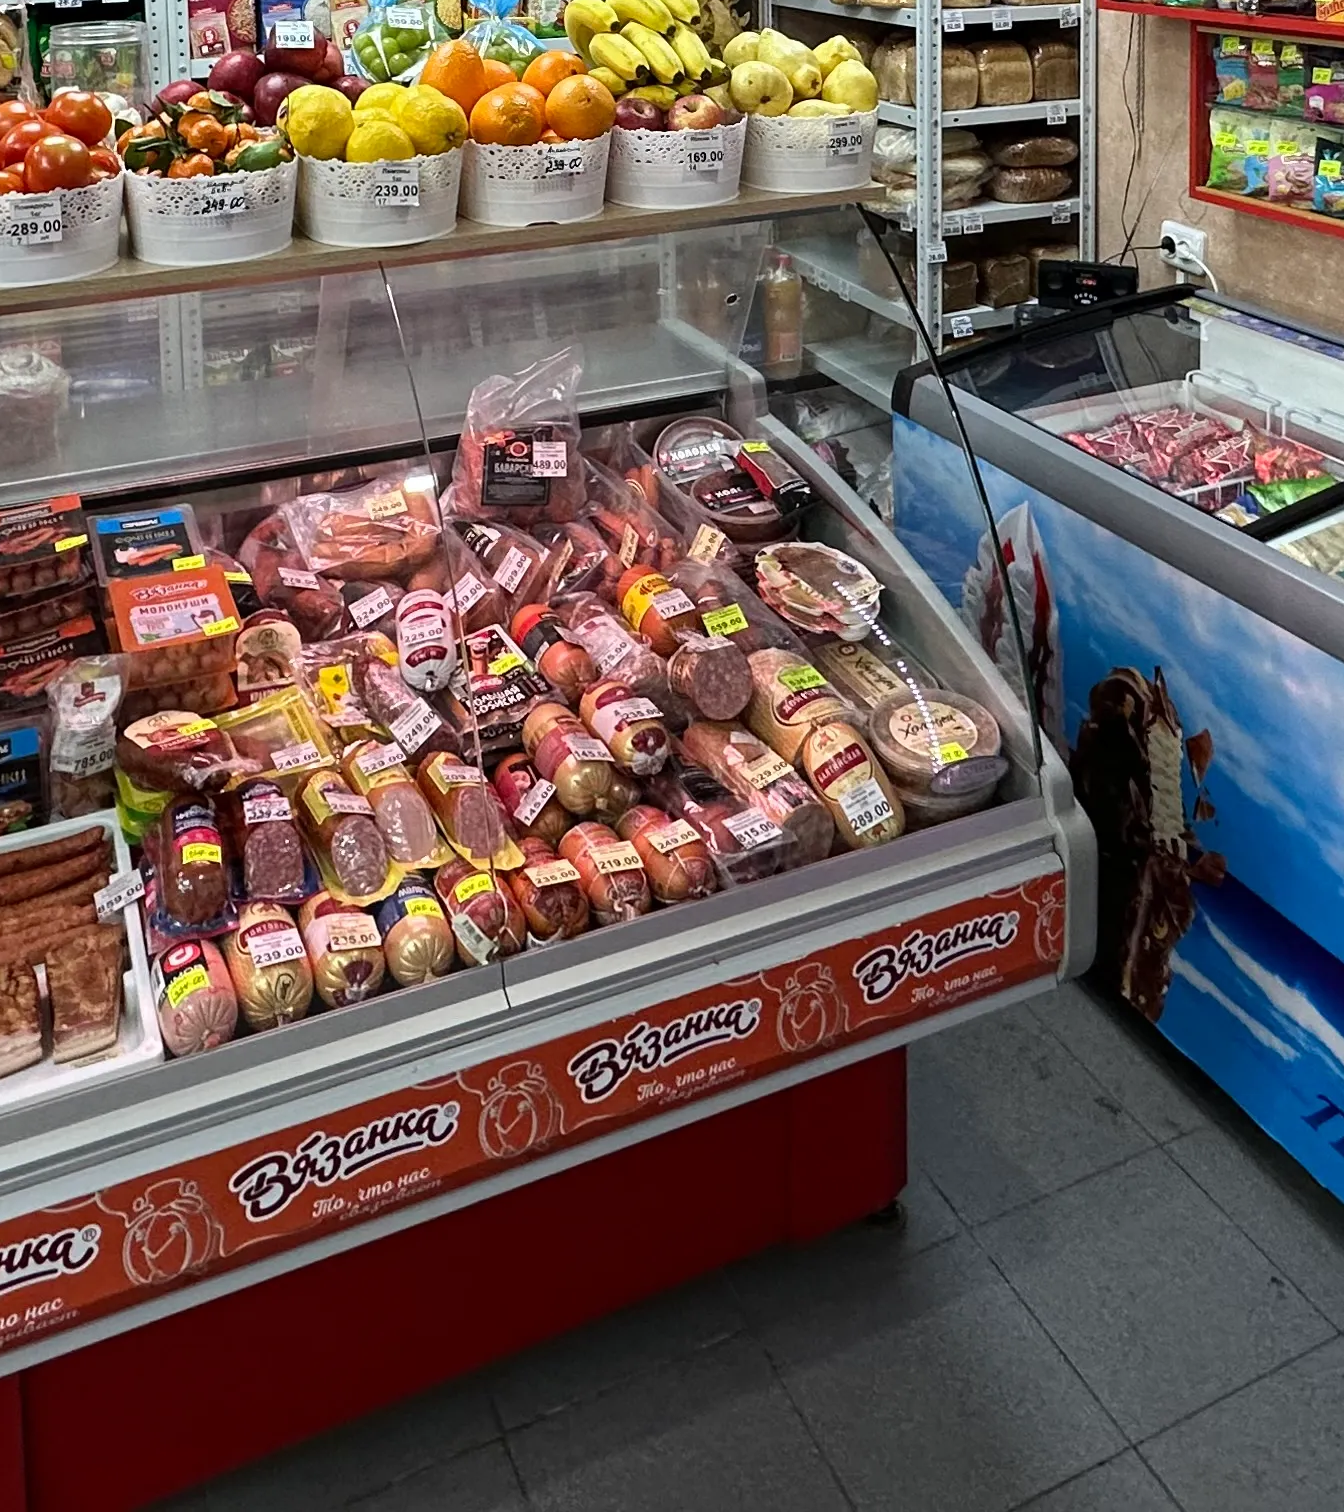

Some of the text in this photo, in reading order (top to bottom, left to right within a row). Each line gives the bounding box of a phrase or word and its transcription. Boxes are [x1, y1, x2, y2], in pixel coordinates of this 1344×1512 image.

[830, 135, 862, 149] 299.00
[687, 151, 724, 163] 169.00
[374, 185, 418, 199] 239.00
[11, 220, 61, 236] 289.00
[533, 460, 566, 469] 489.00
[599, 856, 639, 869] 219.00
[254, 946, 303, 964] 239.00
[857, 916, 1015, 1001] Вязанка
[571, 1003, 759, 1099] Вязанка
[234, 1108, 453, 1218] Вязанка
[397, 1167, 431, 1188] нас
[25, 1297, 63, 1322] нас
